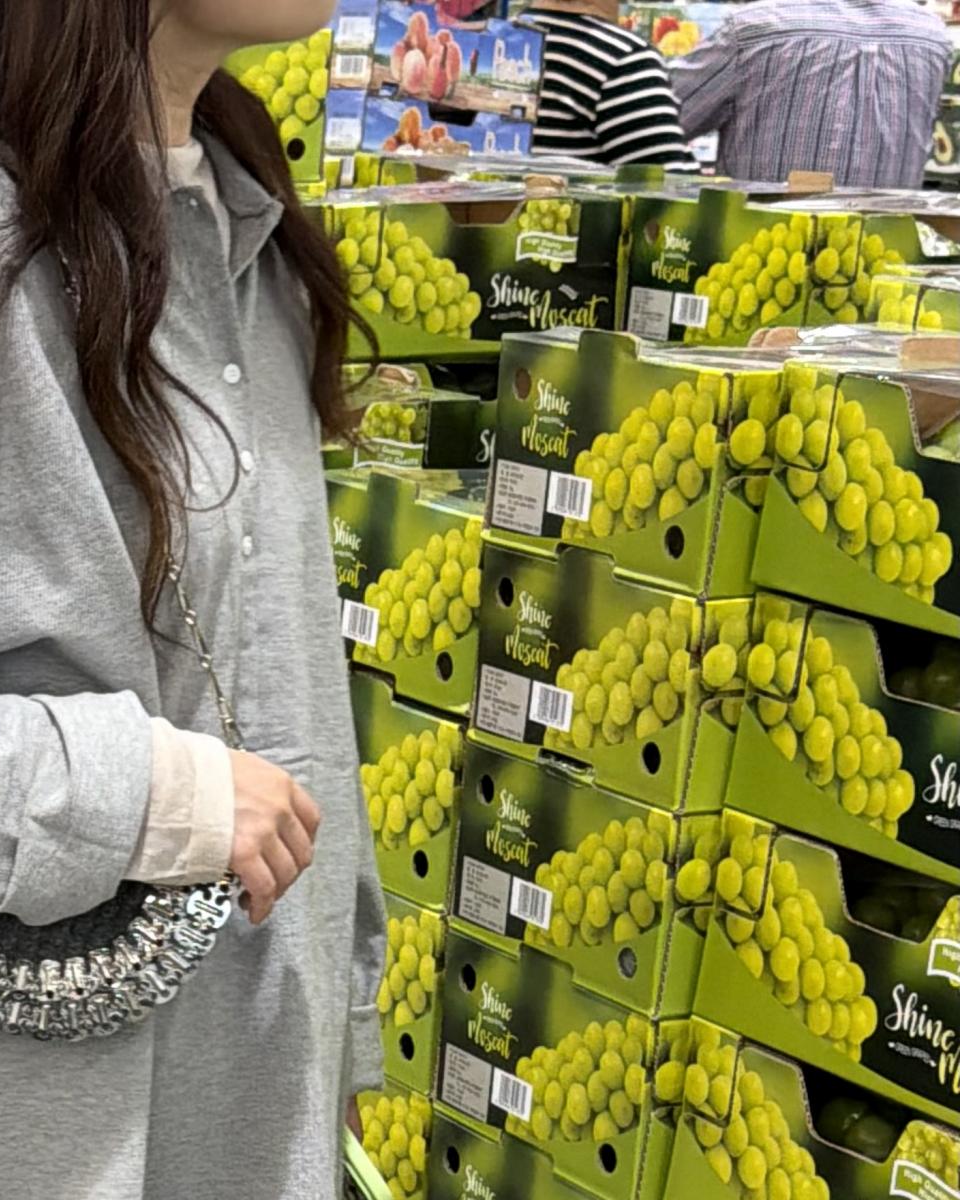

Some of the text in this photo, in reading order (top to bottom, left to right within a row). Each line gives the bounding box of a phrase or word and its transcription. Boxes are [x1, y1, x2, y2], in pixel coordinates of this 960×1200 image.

[487, 272, 540, 308] Shine
[535, 378, 571, 416] Shine
[517, 590, 552, 629] Shine
[498, 788, 531, 828] Shine
[478, 981, 512, 1022] Shine
[884, 983, 955, 1051] Shine
